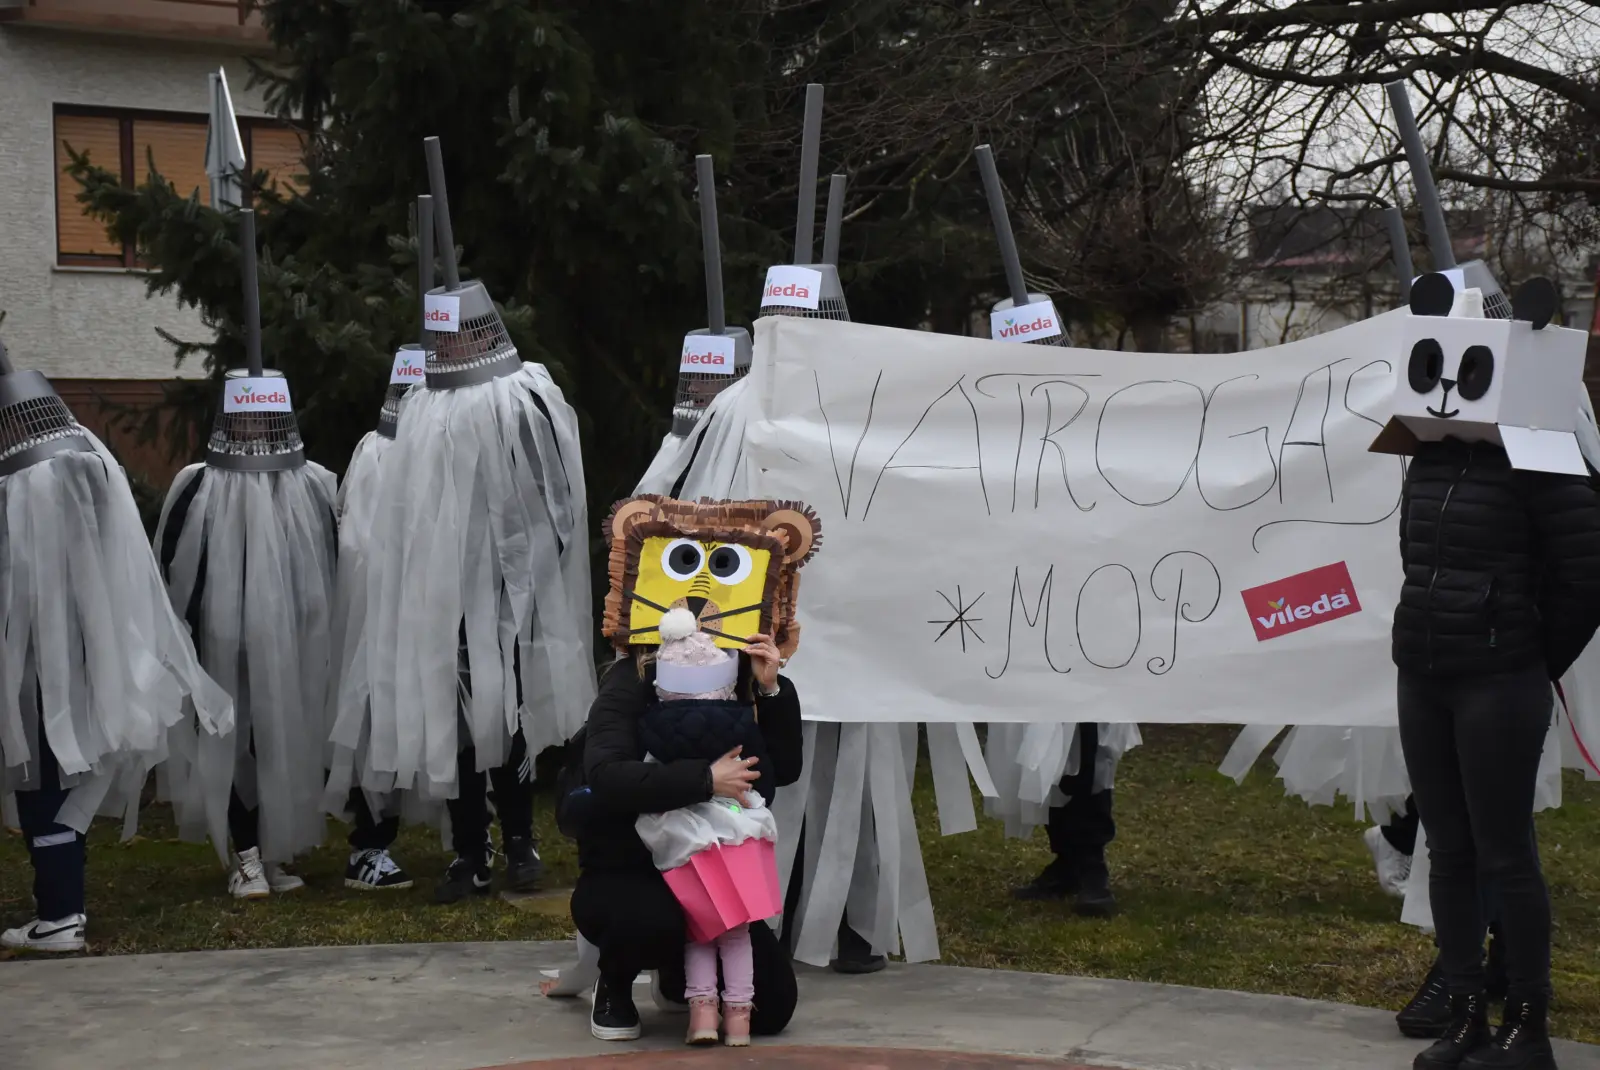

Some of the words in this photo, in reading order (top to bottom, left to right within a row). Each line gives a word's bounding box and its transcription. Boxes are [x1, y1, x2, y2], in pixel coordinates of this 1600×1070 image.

[998, 318, 1053, 338] vileda
[396, 365, 423, 376] vile
[233, 391, 287, 405] vileda
[1256, 593, 1352, 629] vileda
